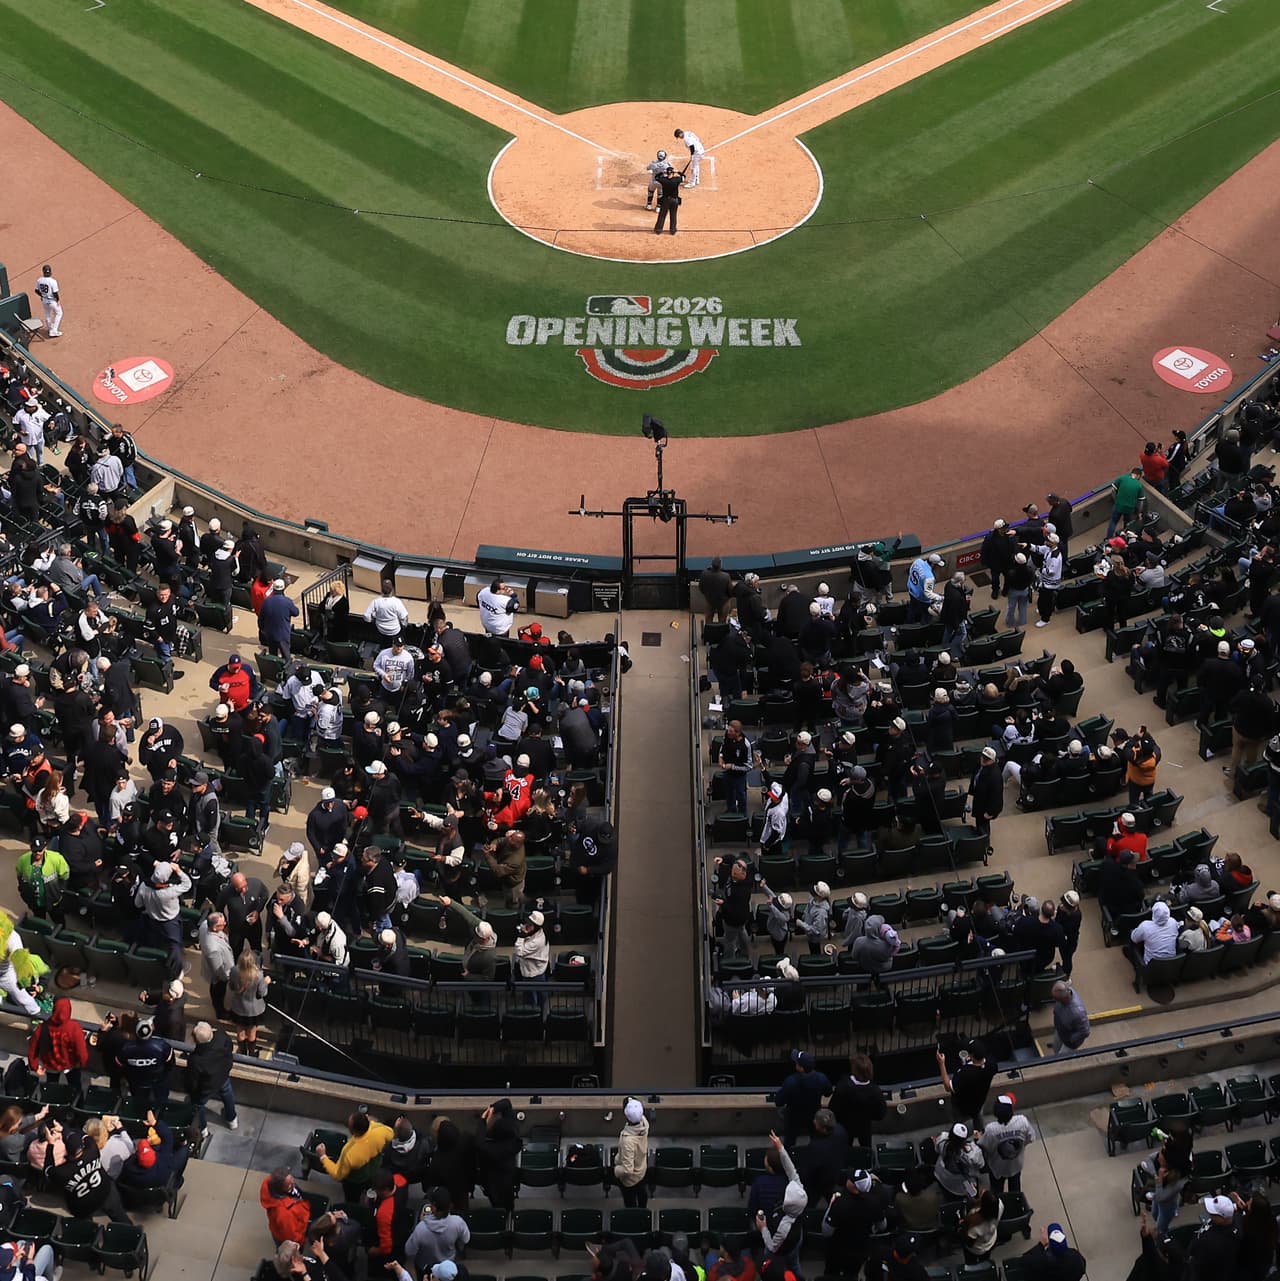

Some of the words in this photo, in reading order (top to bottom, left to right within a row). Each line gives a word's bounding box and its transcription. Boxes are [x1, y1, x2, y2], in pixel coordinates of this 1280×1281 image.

[657, 295, 723, 316] 2026
[505, 314, 683, 346] OPENING
[687, 315, 802, 347] WEEK
[1193, 367, 1229, 390] TOYOTA
[481, 600, 498, 614] SOX
[76, 1170, 102, 1198] 29
